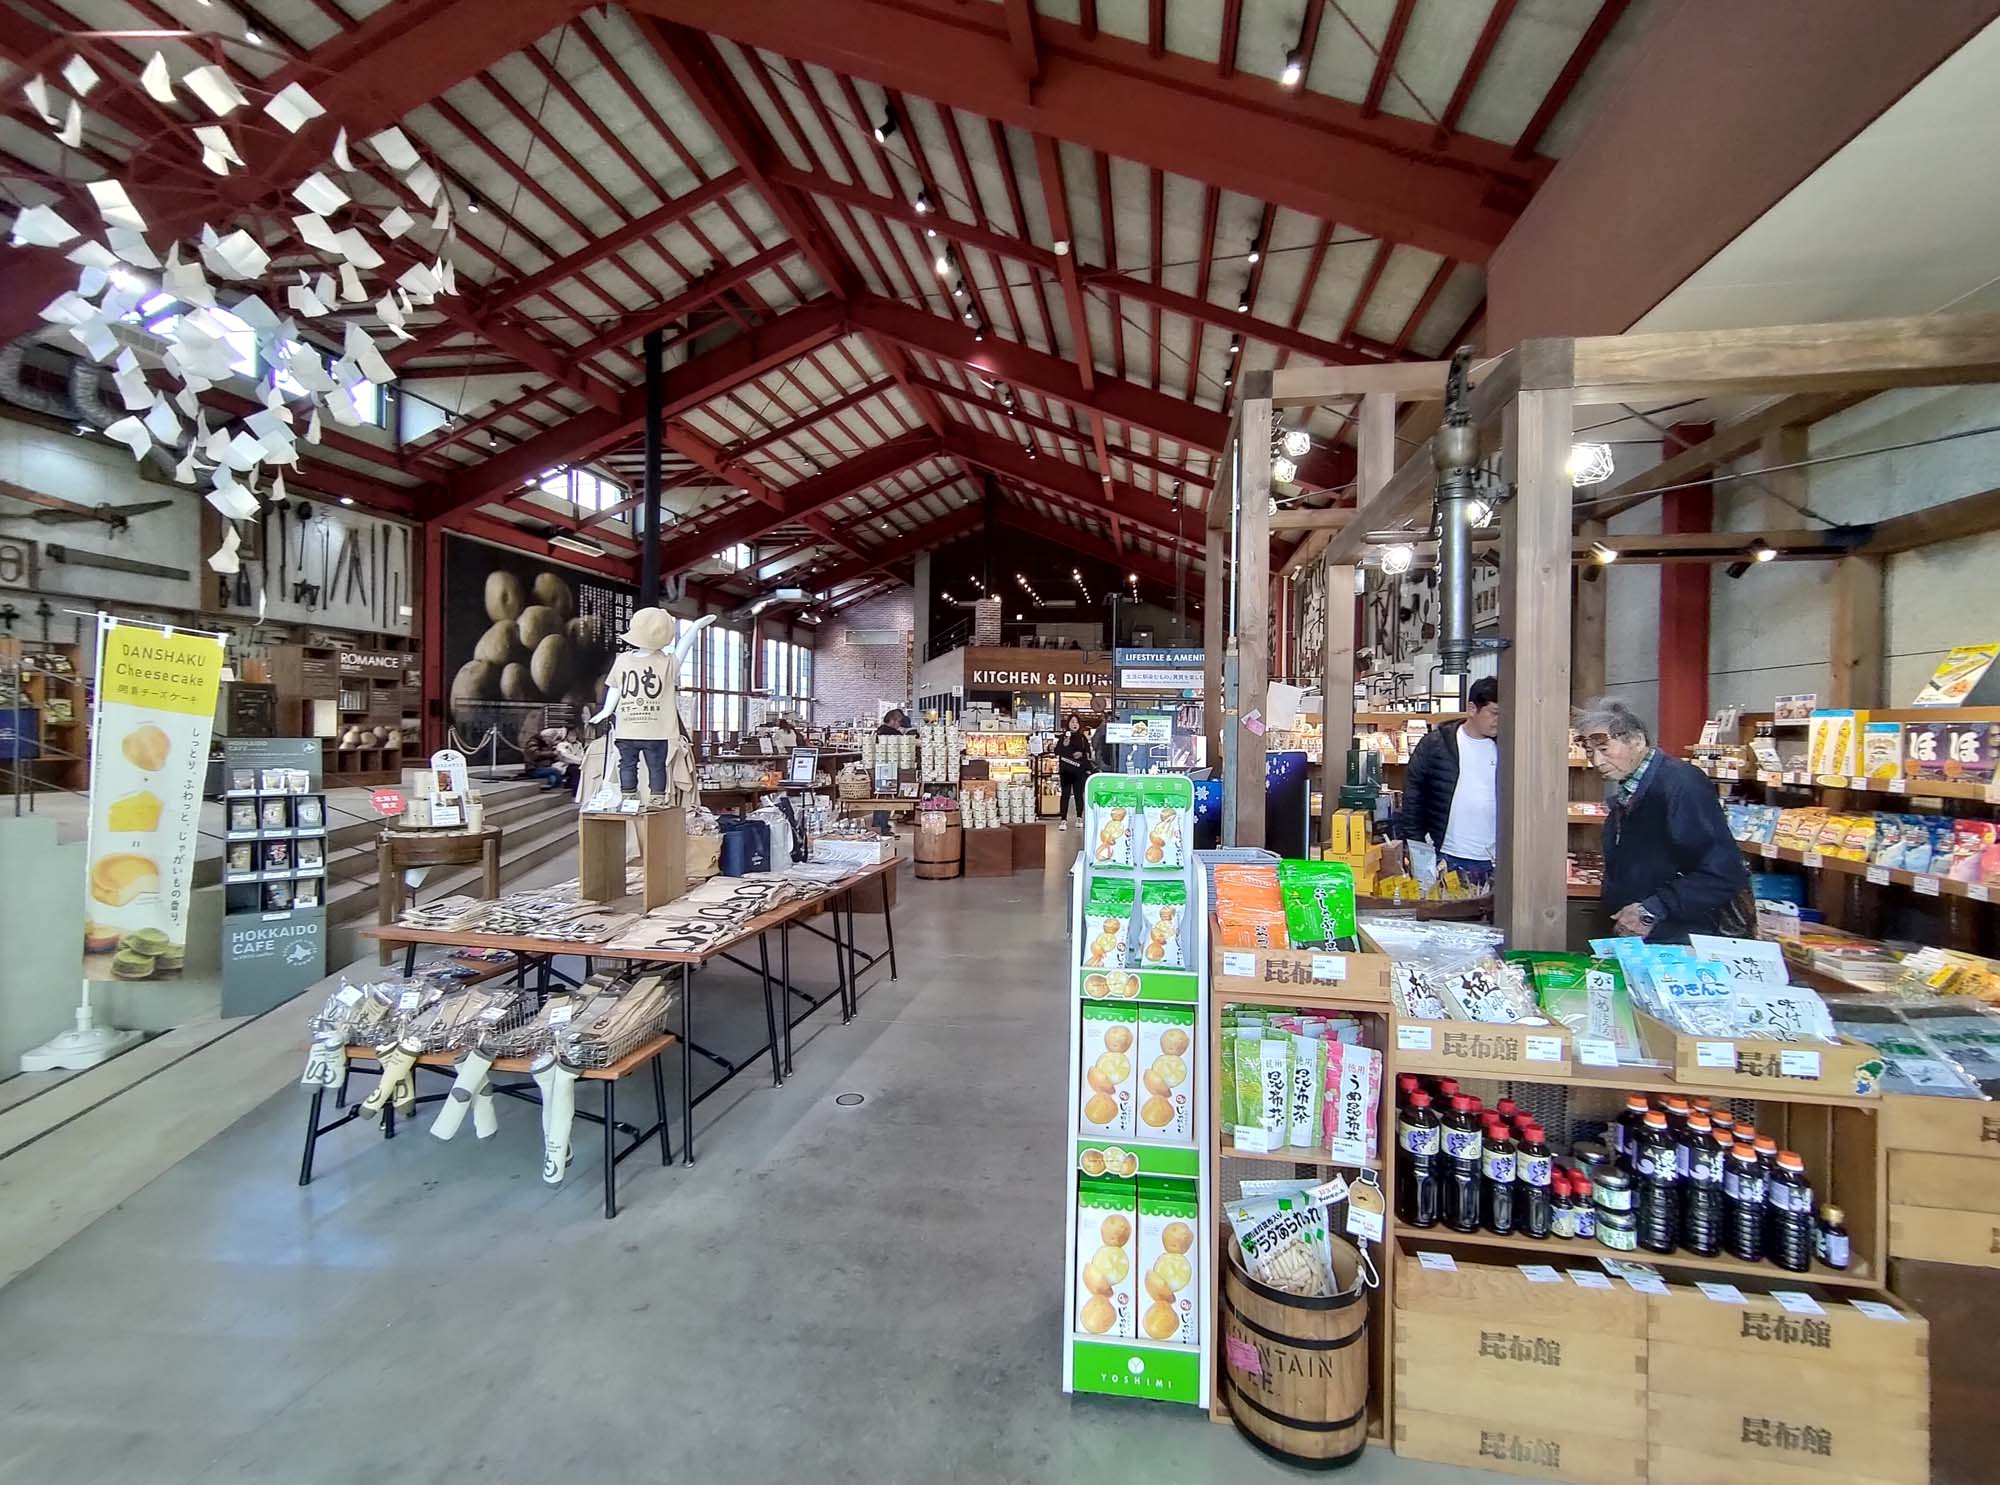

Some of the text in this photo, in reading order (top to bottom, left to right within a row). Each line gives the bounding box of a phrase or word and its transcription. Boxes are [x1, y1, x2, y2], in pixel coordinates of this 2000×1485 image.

[122, 644, 206, 667] DANSHAKU
[340, 653, 399, 668] ROMANCE
[116, 663, 204, 686] Cheesecake
[621, 666, 662, 699] いも
[973, 671, 1041, 685] KITCHEN
[1047, 674, 1057, 685] &
[232, 924, 318, 942] HOKKAIDO
[232, 940, 275, 954] CAFE
[1669, 983, 1730, 998] ゆきんこ
[1442, 1032, 1518, 1061] 昆布館
[1740, 1311, 1831, 1348] 昆布館
[1478, 1330, 1561, 1367] 昆布館
[1101, 1373, 1172, 1389] YOSHIMI
[1740, 1416, 1832, 1457] 昆布館
[1478, 1431, 1560, 1468] 昆布館
